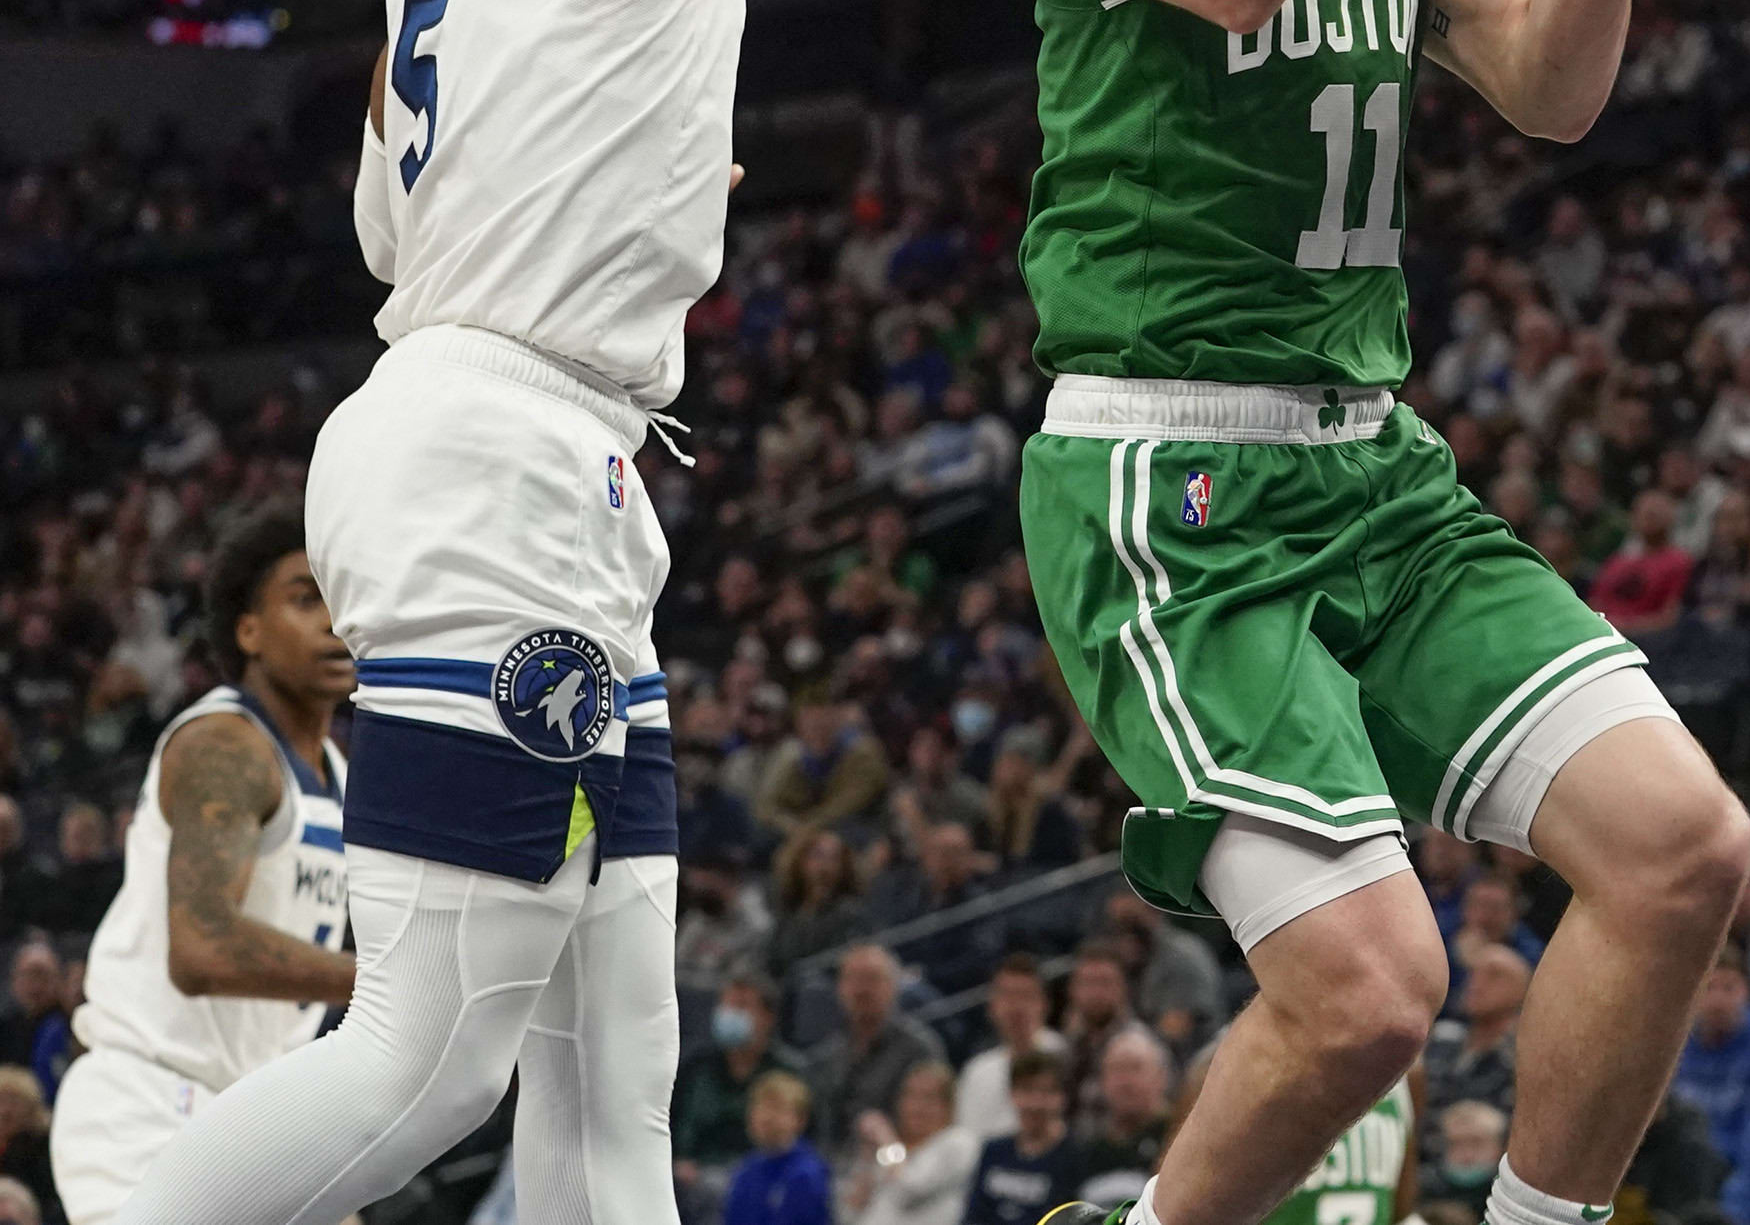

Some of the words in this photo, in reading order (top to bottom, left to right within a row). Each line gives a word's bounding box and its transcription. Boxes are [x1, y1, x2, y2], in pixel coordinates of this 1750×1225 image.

[1295, 83, 1402, 270] 11
[498, 633, 562, 702] MINNESOTA
[571, 635, 611, 746] TIMBERWOLVES
